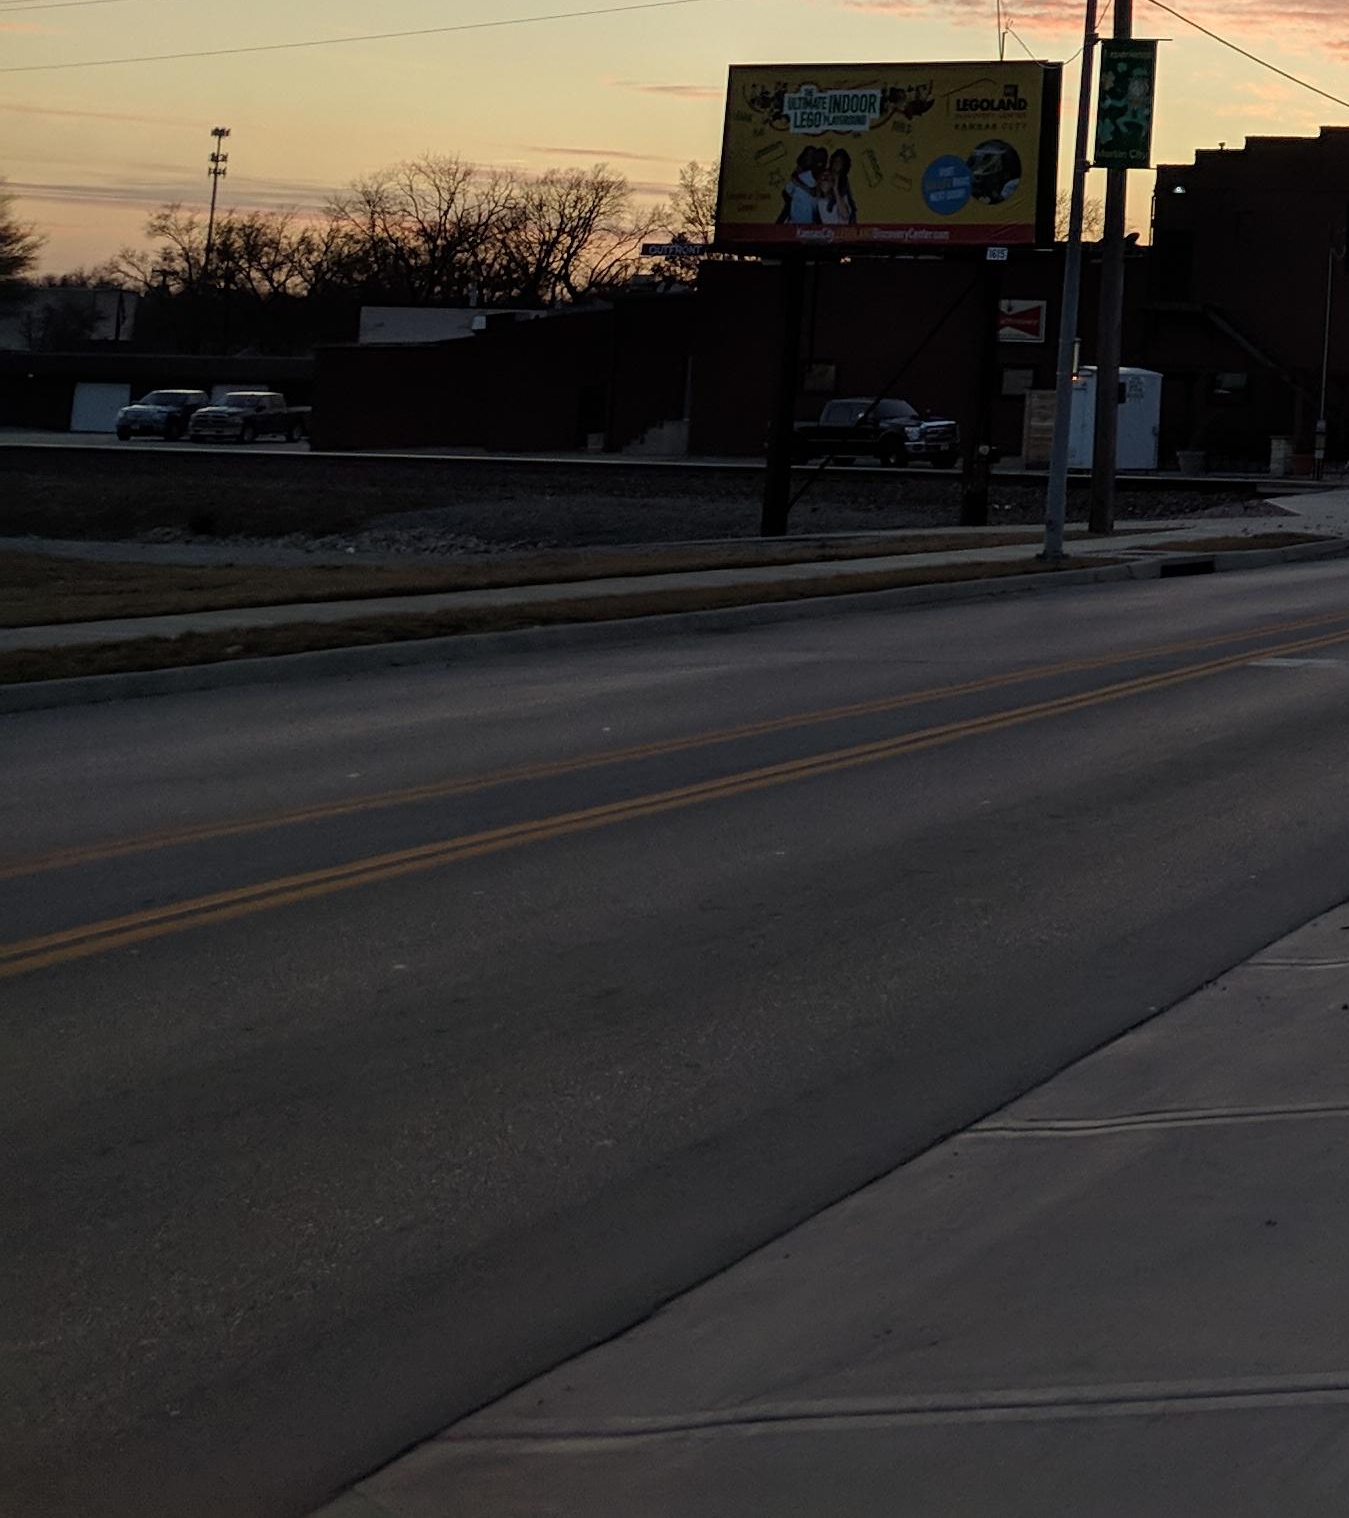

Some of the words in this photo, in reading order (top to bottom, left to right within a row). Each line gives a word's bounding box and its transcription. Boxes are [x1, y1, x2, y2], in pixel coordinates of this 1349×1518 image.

[829, 94, 877, 113] INDOOR
[956, 97, 1028, 111] LEGOLAND
[794, 112, 822, 128] LEGO
